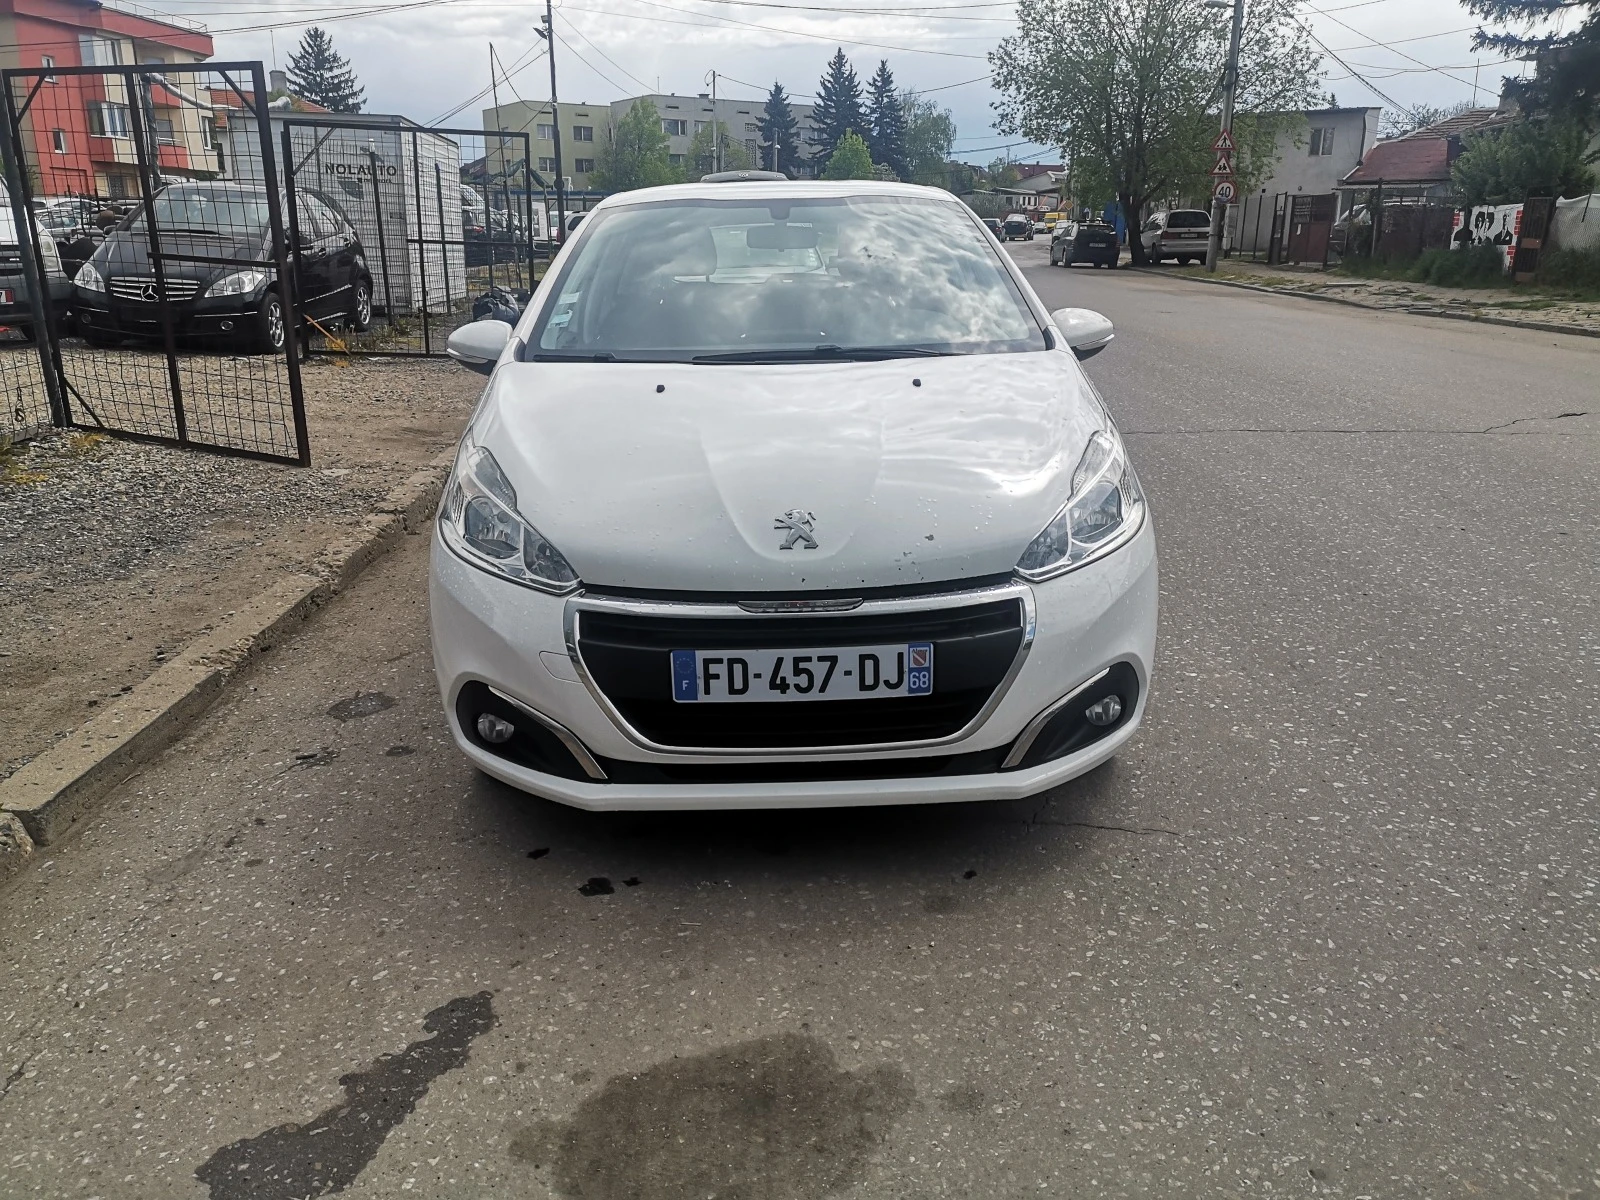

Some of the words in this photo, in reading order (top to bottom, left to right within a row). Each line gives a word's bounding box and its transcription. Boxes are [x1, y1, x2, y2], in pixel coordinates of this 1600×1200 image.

[1218, 186, 1231, 198] 40
[682, 680, 690, 691] F
[702, 651, 905, 696] FD-457-DJ
[910, 671, 929, 688] 68
